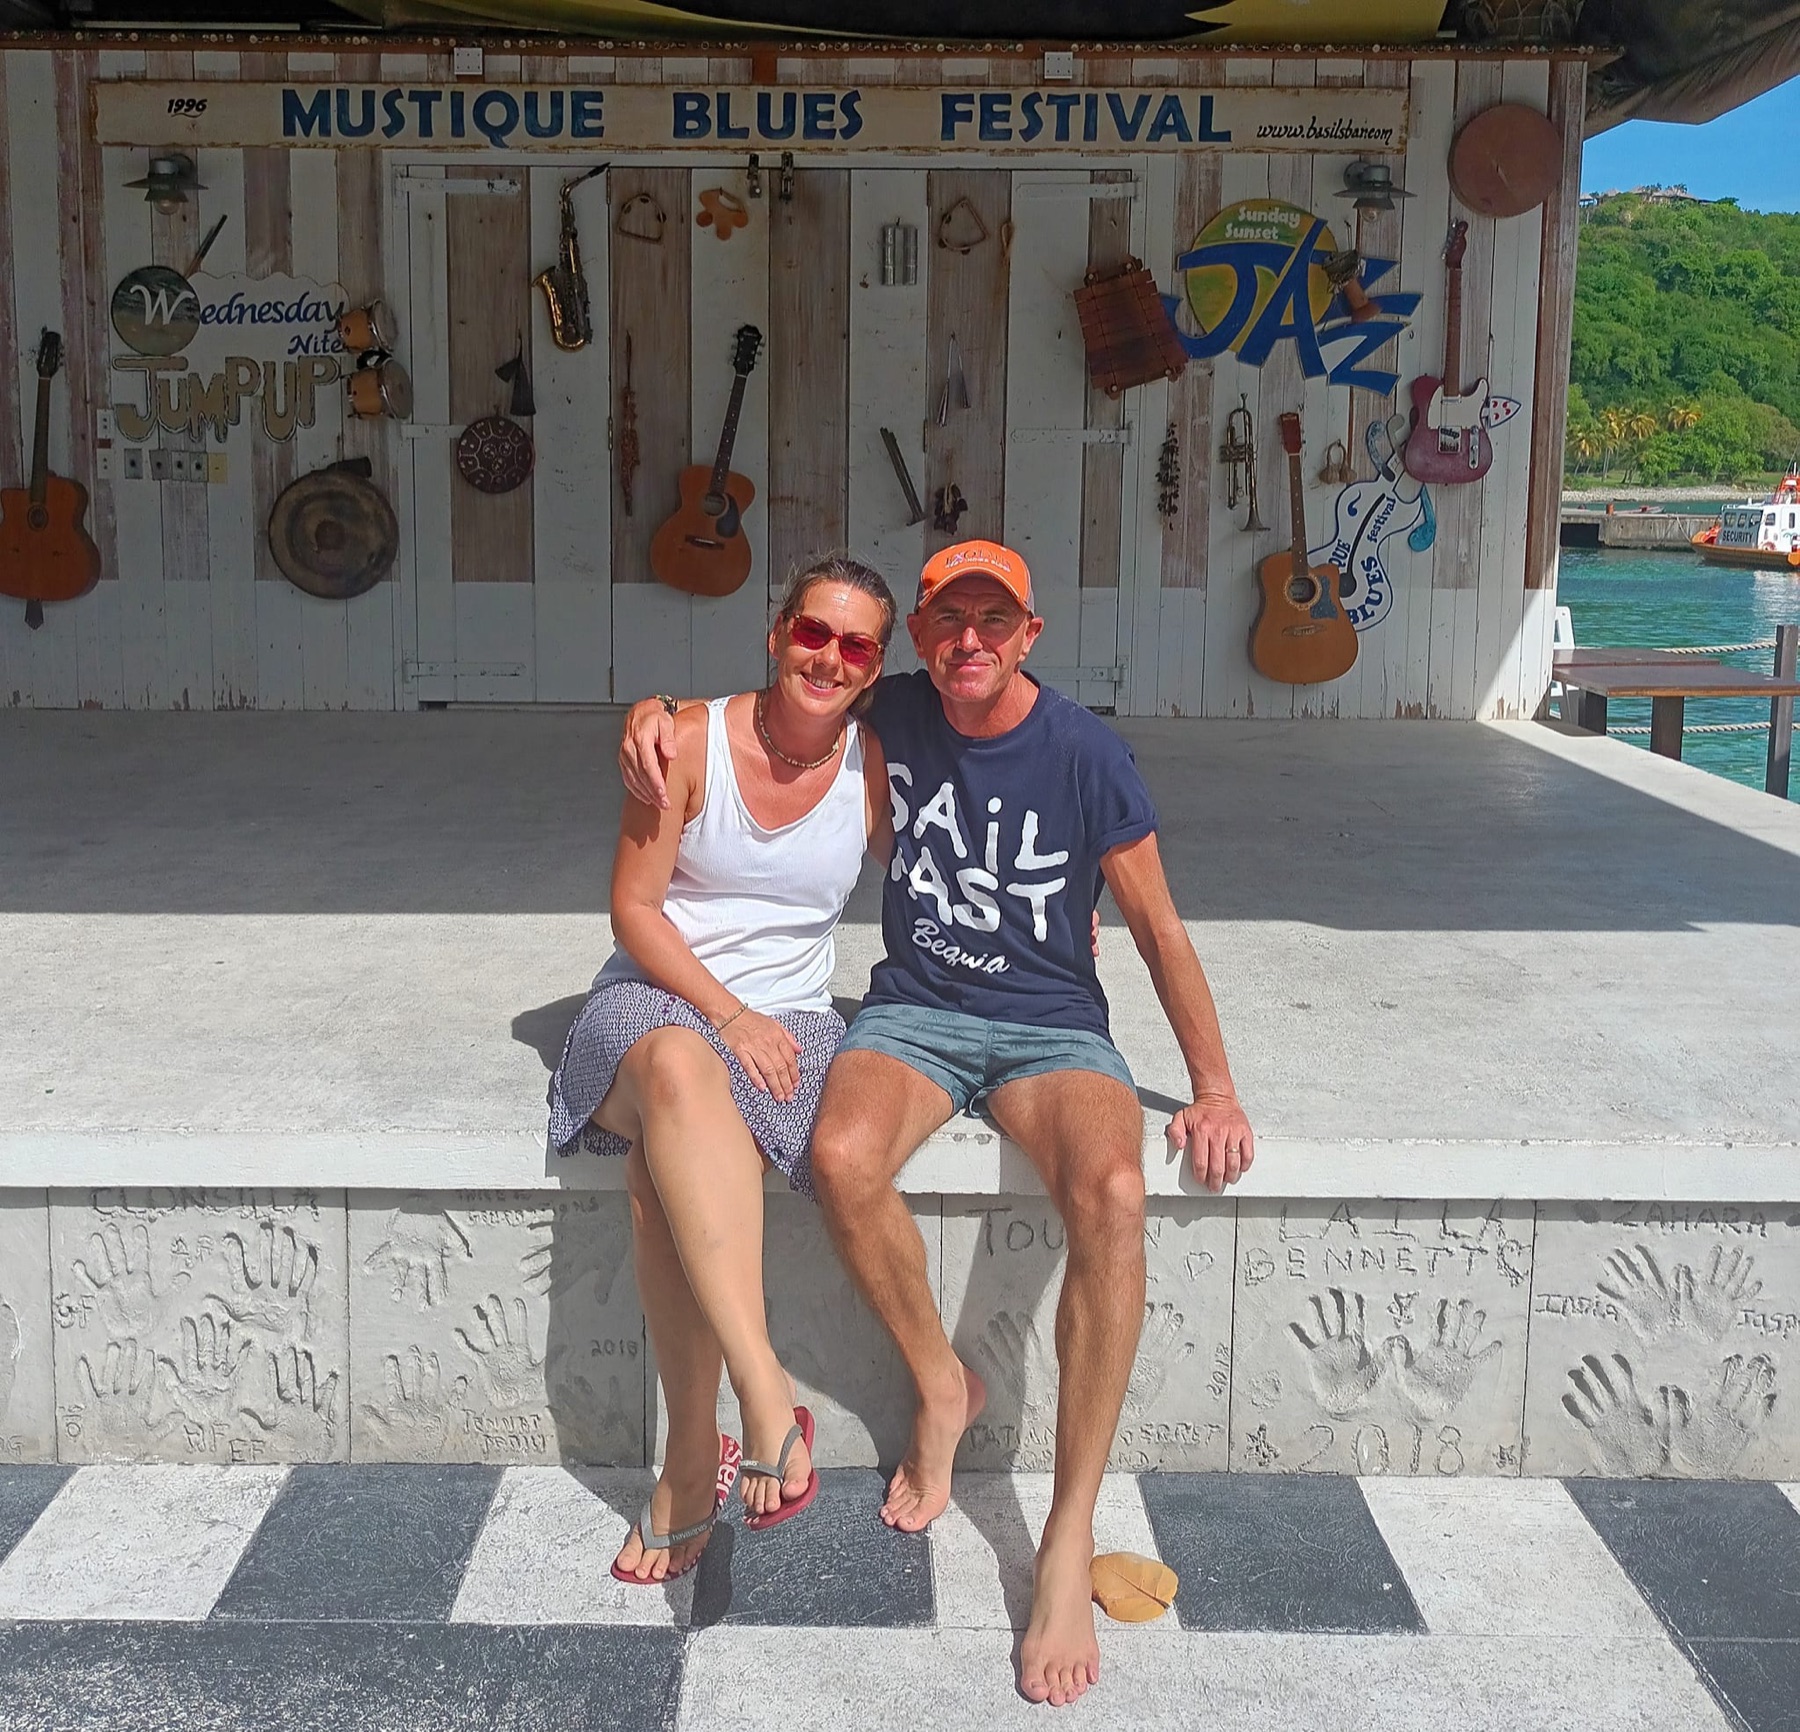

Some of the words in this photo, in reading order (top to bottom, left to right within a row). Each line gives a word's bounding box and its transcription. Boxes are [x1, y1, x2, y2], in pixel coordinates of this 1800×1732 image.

[166, 97, 207, 116] 1996
[282, 88, 604, 149] MUSTIQUE
[672, 89, 863, 141] BLUES
[940, 90, 1233, 143] FESTIVAL
[1224, 223, 1280, 240] Sunset
[1237, 205, 1301, 227] Sunday
[129, 284, 344, 334] Wednesday
[287, 332, 343, 355] Nite
[1346, 556, 1385, 626] BLUES
[1366, 496, 1396, 544] festival
[1722, 530, 1754, 543] SECURITY
[911, 917, 1011, 974] Bequia
[1298, 1424, 1465, 1475] 2018
